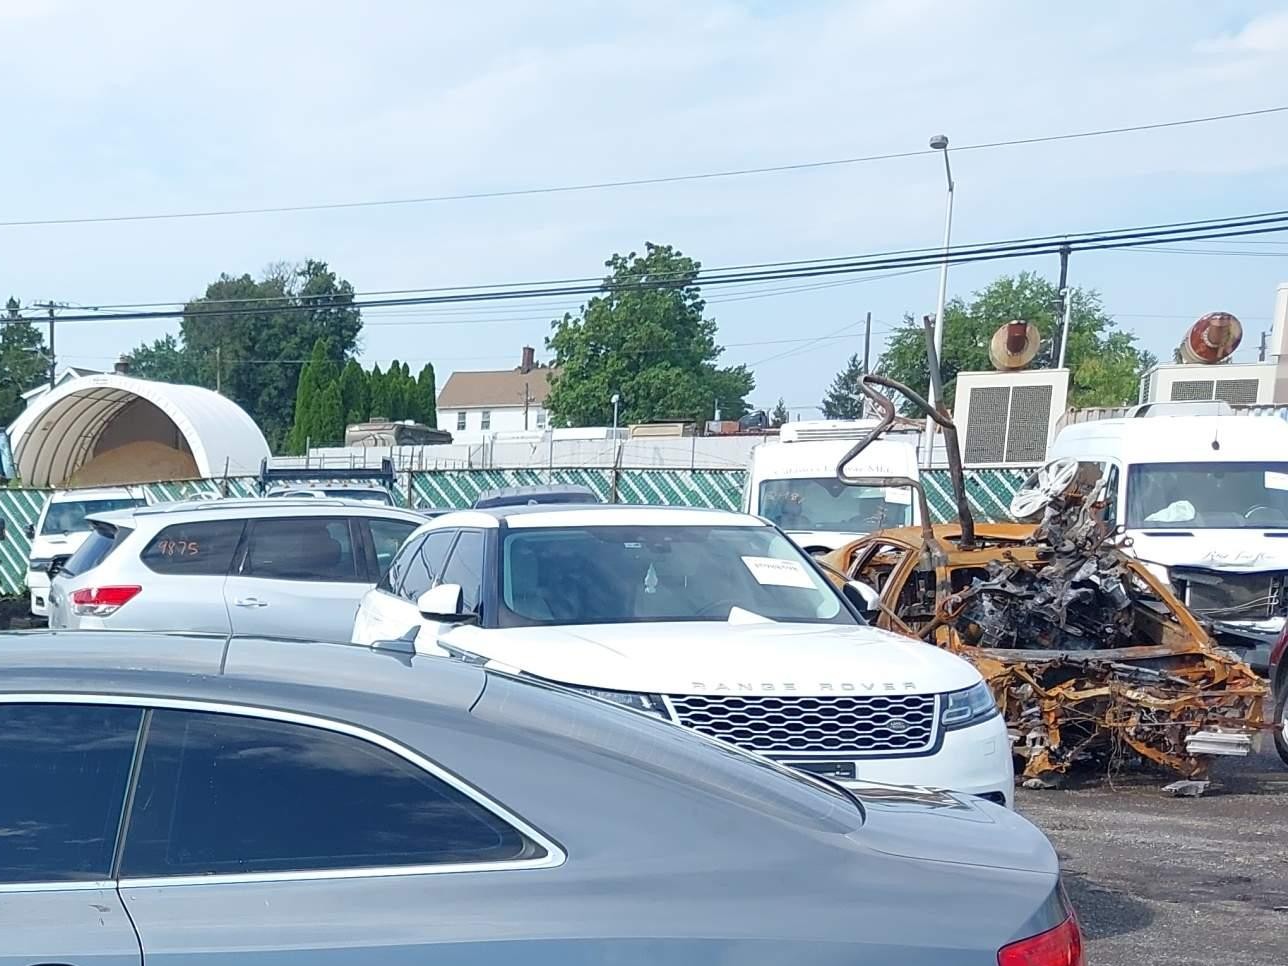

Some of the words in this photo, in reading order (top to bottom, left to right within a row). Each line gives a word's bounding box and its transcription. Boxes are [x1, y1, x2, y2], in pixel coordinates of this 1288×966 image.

[158, 539, 199, 556] 9875
[691, 681, 798, 692] RANGE
[818, 681, 917, 692] ROVER
